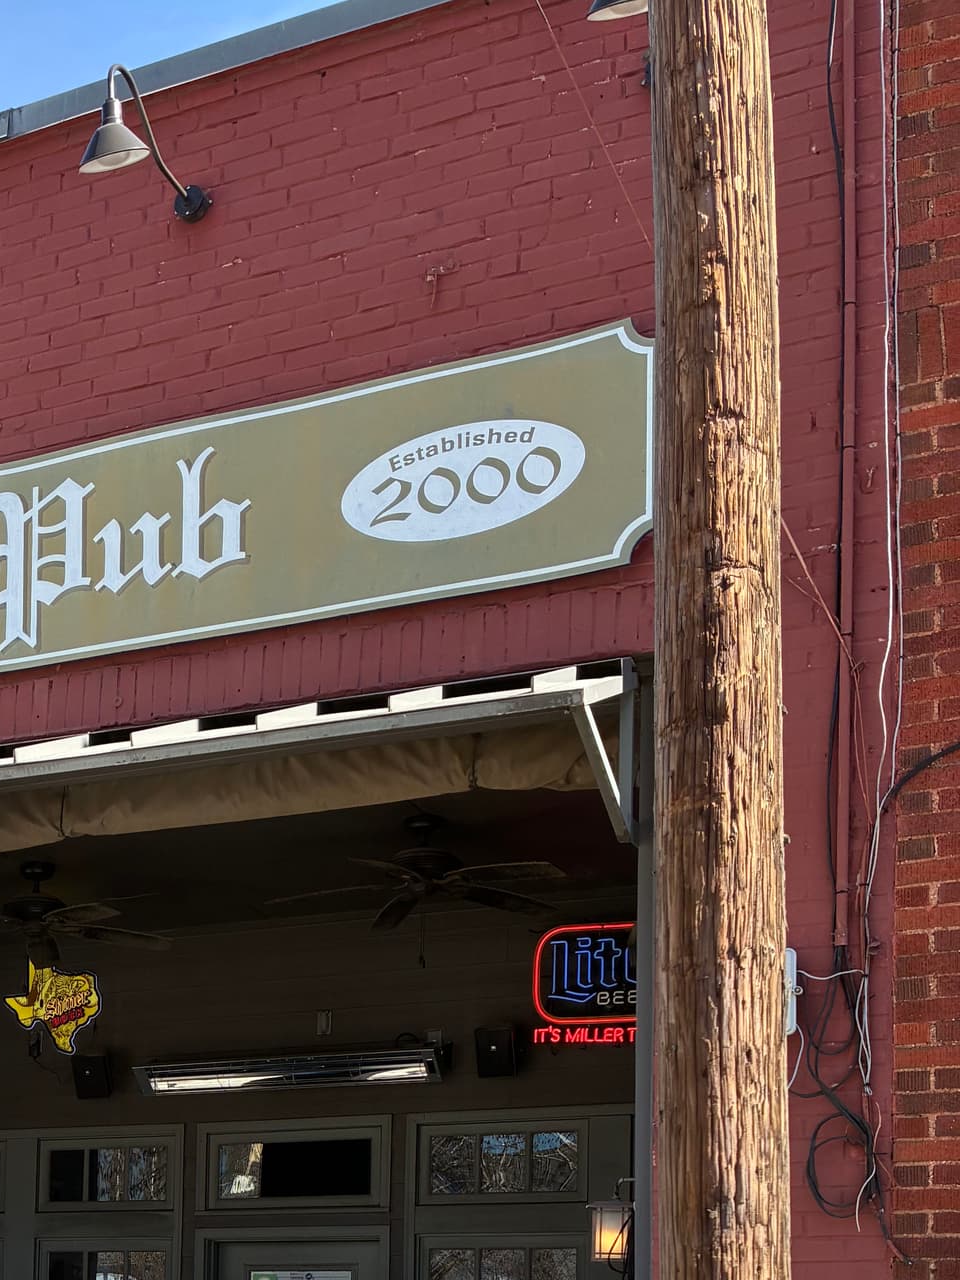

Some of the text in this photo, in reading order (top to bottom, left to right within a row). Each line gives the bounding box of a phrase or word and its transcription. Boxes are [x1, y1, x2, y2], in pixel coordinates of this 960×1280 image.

[389, 426, 536, 473] Established
[369, 446, 562, 528] 2000
[547, 936, 638, 1004] Lit
[596, 990, 638, 1005] BEE
[533, 1025, 562, 1043] IT'S
[564, 1026, 625, 1043] MILLER
